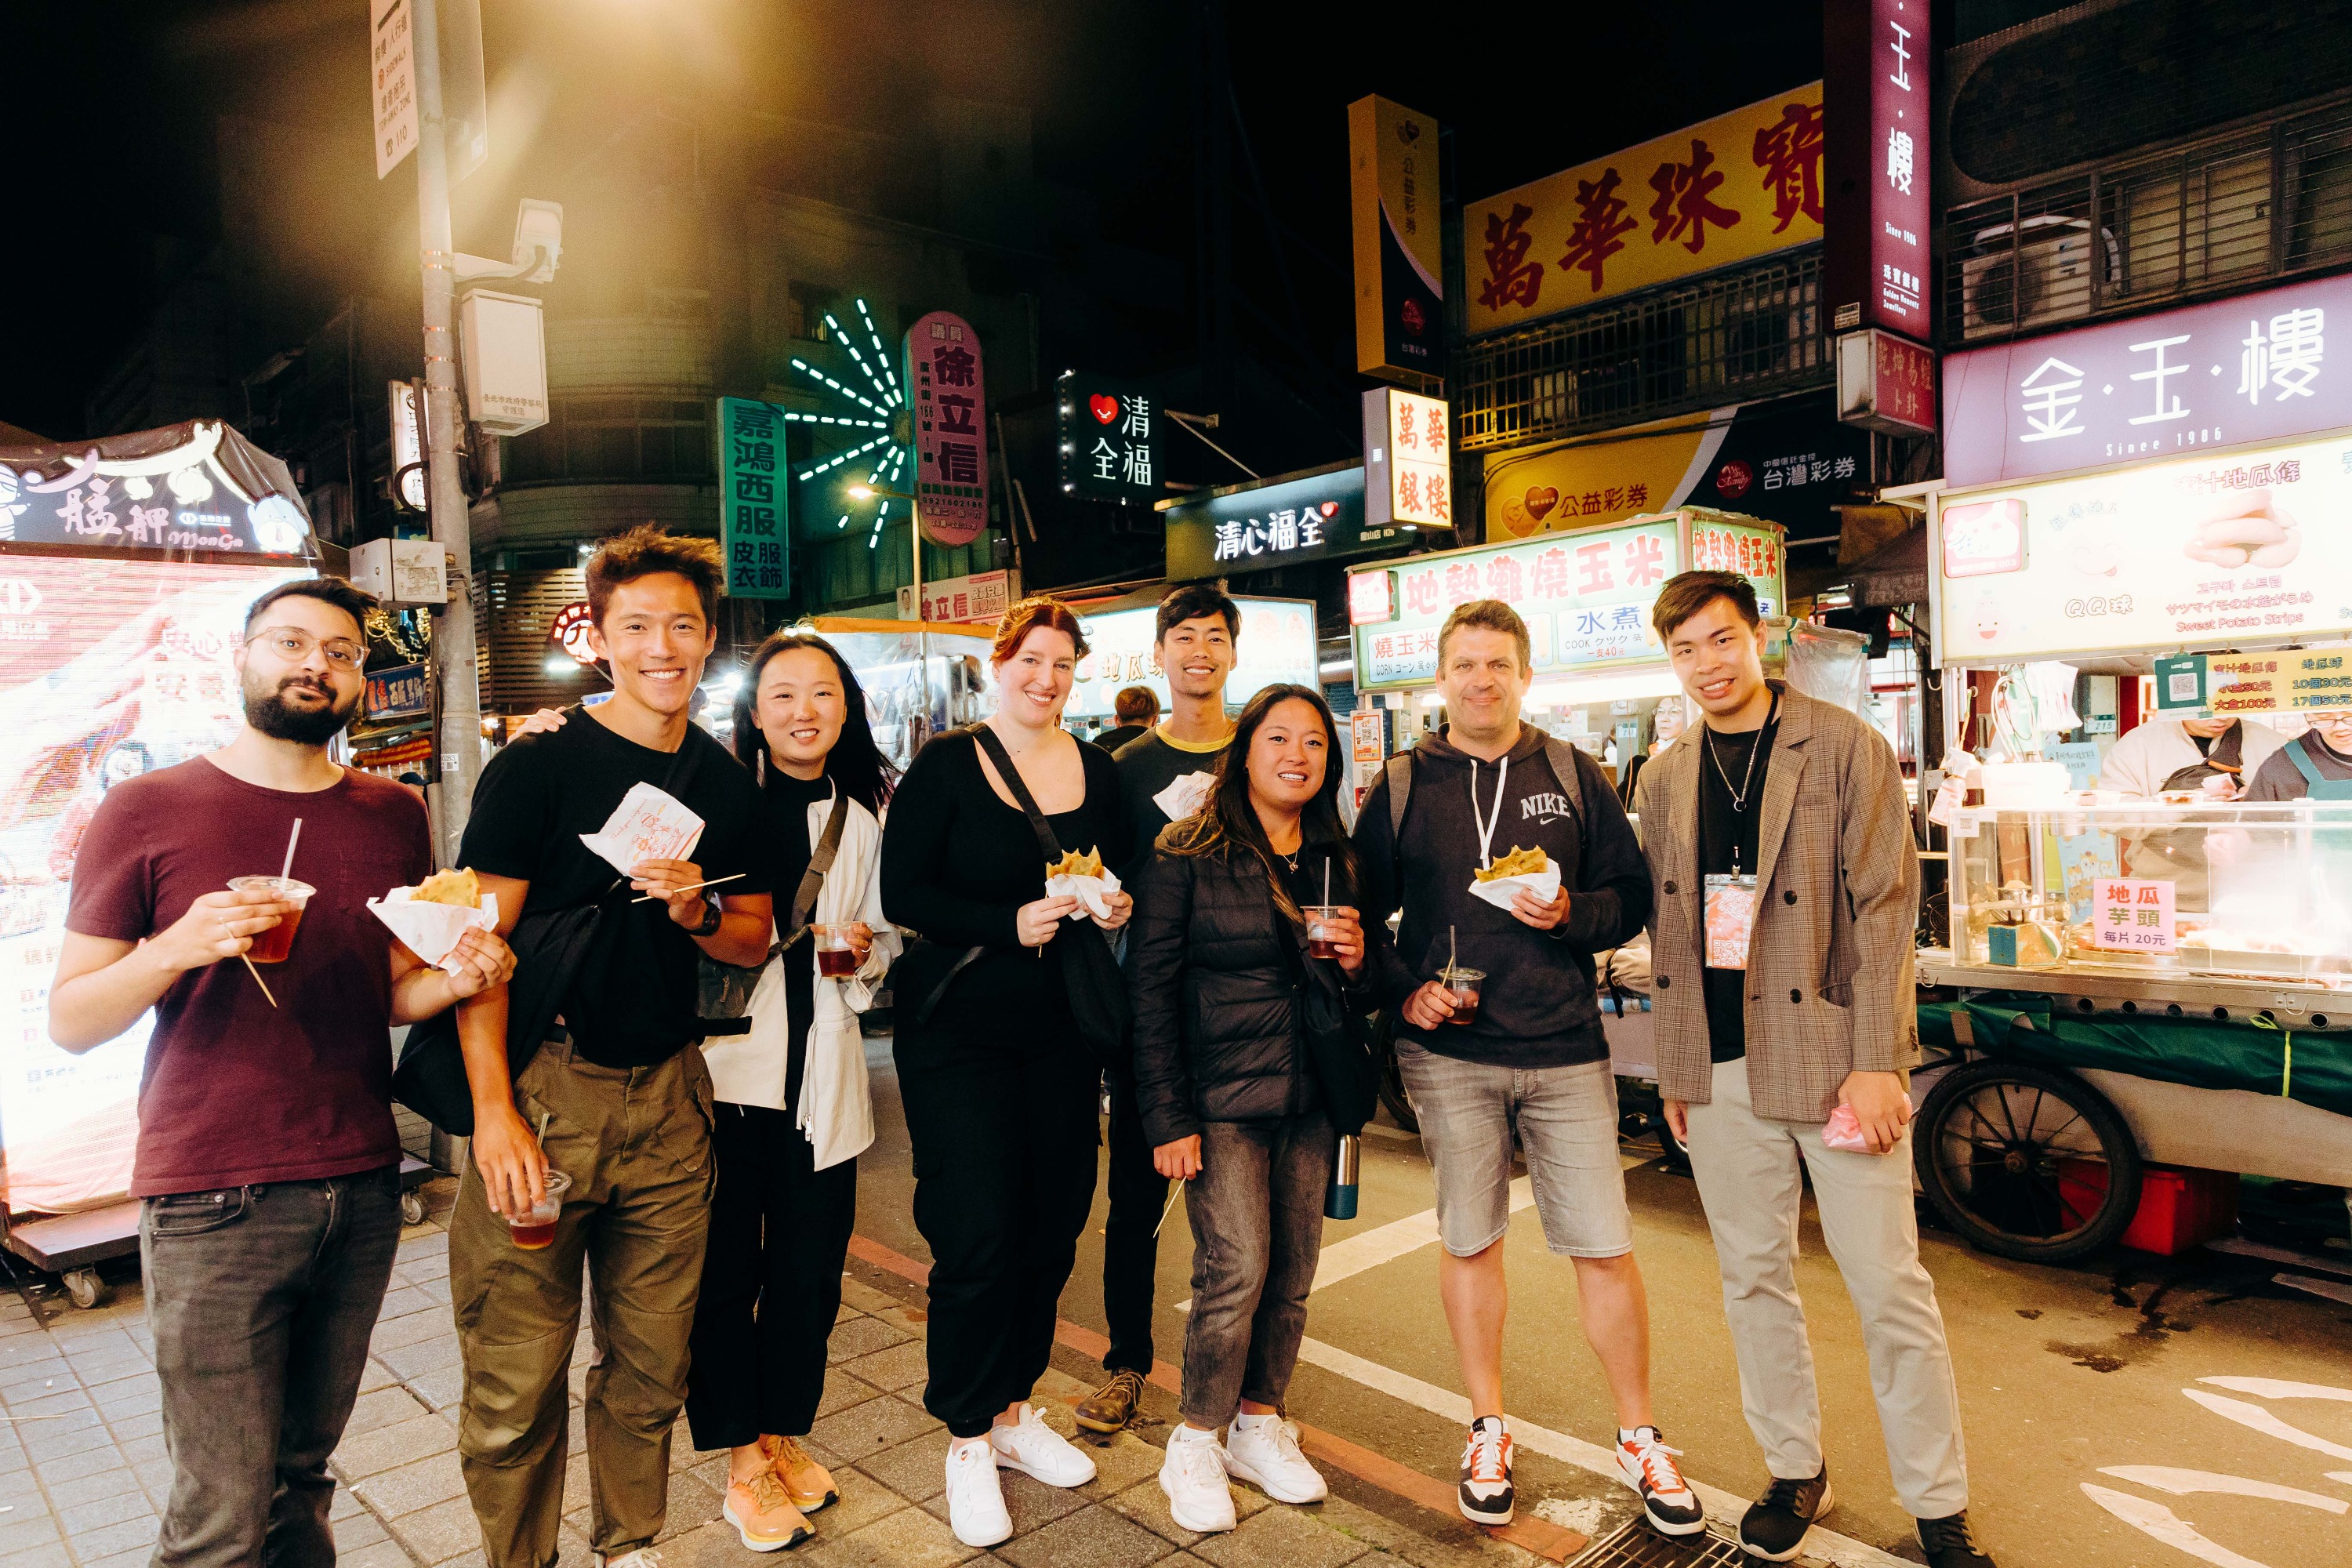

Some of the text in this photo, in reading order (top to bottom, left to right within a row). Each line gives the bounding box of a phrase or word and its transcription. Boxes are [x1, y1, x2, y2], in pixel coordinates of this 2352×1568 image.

[933, 345, 978, 485] 徐立信
[2106, 427, 2222, 457] Since 1986
[733, 405, 776, 537] 嘉鴻西服
[1763, 456, 1856, 490] 台灣彩券
[1559, 483, 1648, 519] 公益彩券
[1214, 506, 1325, 561] 清心福全
[1577, 606, 1642, 634] 水煮
[2176, 612, 2304, 632] Sweet Potato Strips
[1374, 632, 1438, 659] 燒玉米
[1565, 639, 1591, 649] COOK
[1376, 664, 1393, 676] CORN
[2301, 657, 2343, 670] 地瓜球
[2292, 676, 2352, 690] 10個30元
[2214, 694, 2352, 710] 大盒100元 17個50元
[2095, 722, 2112, 731] 215
[1521, 793, 1570, 819] NIKE
[2107, 884, 2160, 905] 地瓜
[2108, 907, 2161, 927] 芋頭
[2104, 931, 2165, 946] 每片 20元
